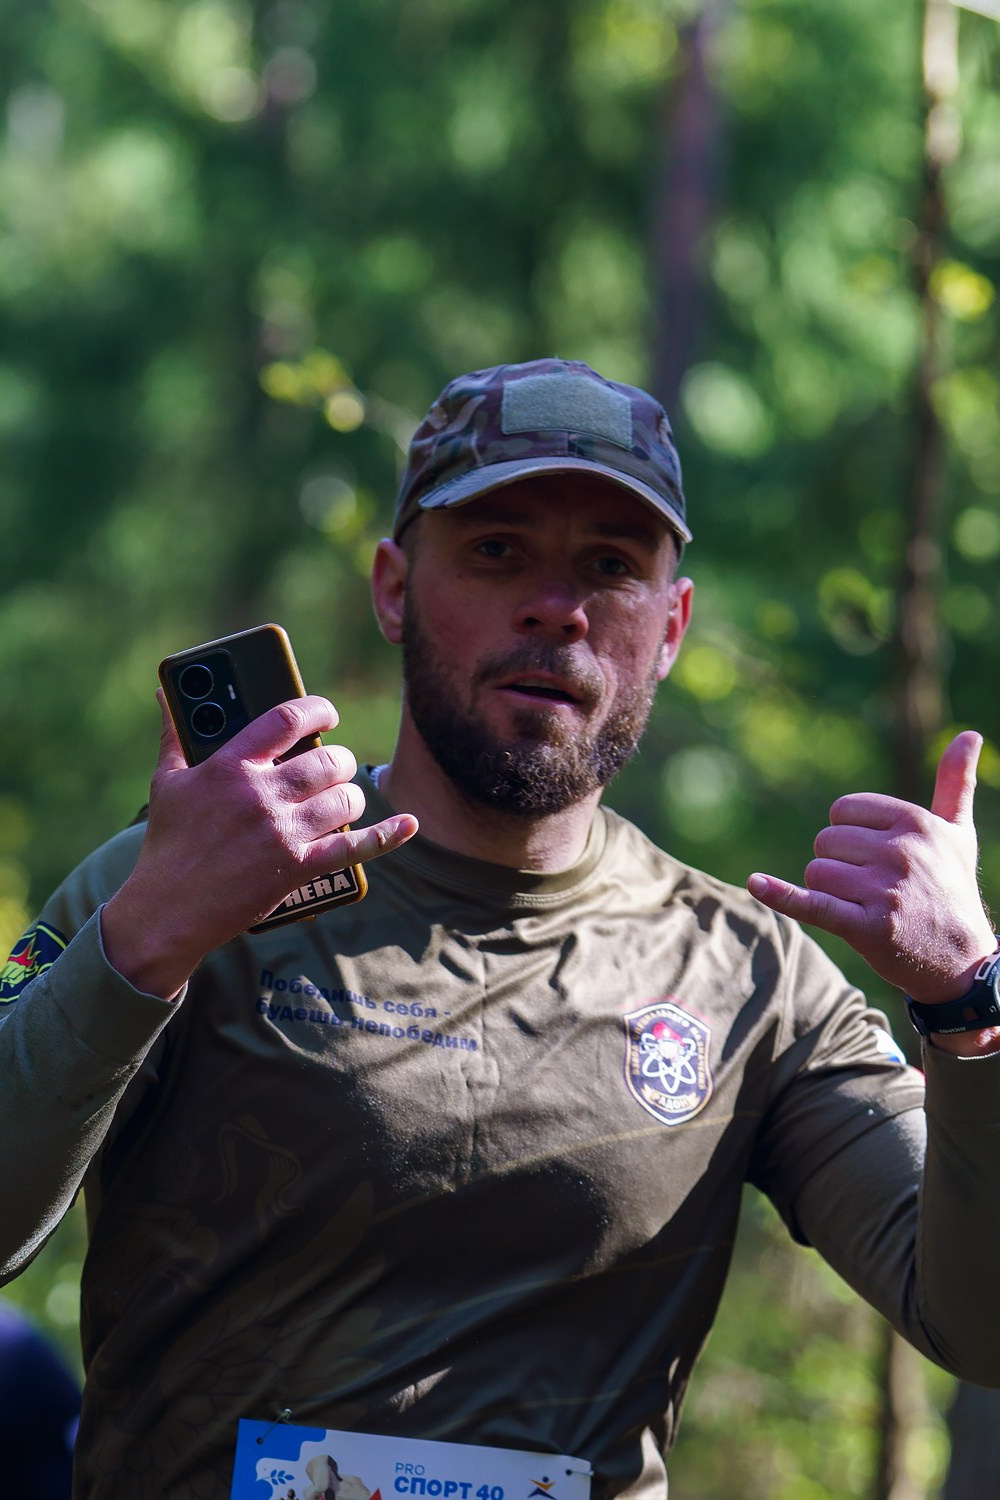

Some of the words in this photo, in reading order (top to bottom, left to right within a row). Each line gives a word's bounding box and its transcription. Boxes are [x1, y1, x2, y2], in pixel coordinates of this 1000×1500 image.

[260, 969, 376, 1010] Победишь
[383, 998, 436, 1019] себя
[255, 997, 345, 1027] будешь
[351, 1016, 478, 1051] непобедим
[395, 1463, 425, 1475] PRO
[394, 1476, 472, 1500] СПОРТ
